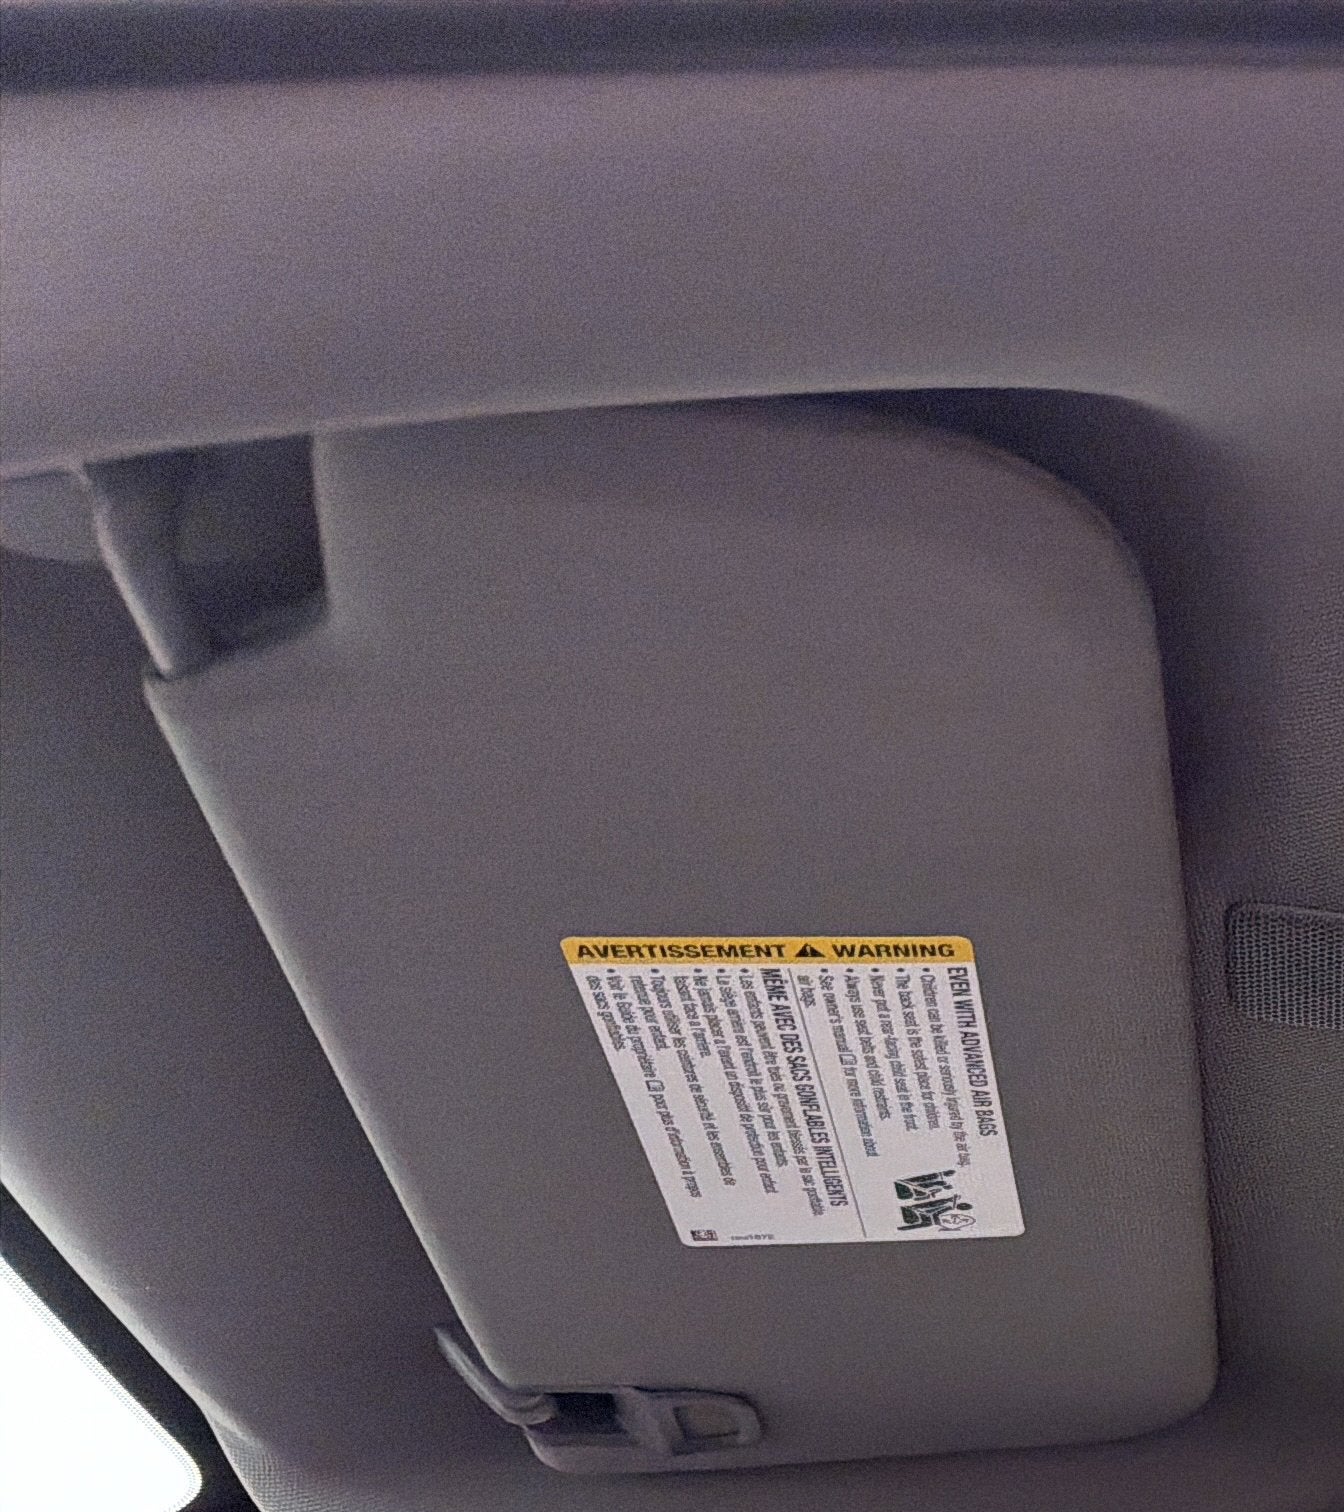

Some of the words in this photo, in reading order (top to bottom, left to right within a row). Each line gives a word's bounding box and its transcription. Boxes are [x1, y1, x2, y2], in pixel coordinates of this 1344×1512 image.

[577, 943, 786, 959] AVERTISSEMENT
[832, 943, 955, 959] WARNING
[759, 968, 793, 1000] MÊME
[818, 975, 836, 990] See
[894, 975, 912, 988] The
[946, 967, 971, 996] EVEN
[822, 993, 845, 1023] owner's
[840, 975, 865, 1002] Always
[854, 1020, 872, 1035] seat
[897, 991, 916, 1009] back
[953, 999, 977, 1027] WITH
[770, 1003, 797, 1030] AVEC
[902, 1011, 919, 1026] seat
[927, 1009, 940, 1021] can
[779, 1033, 803, 1052] DES
[869, 975, 888, 997] Never
[893, 1078, 909, 1092] seat
[908, 1037, 924, 1047] the
[786, 1055, 812, 1081] SACS
[959, 1032, 988, 1086] ADVANCED
[971, 1090, 992, 1106] AIR
[794, 1084, 830, 1143] GONFLABLES
[975, 1110, 997, 1135] BAGS
[812, 1145, 848, 1206] INTELLIGENTS
